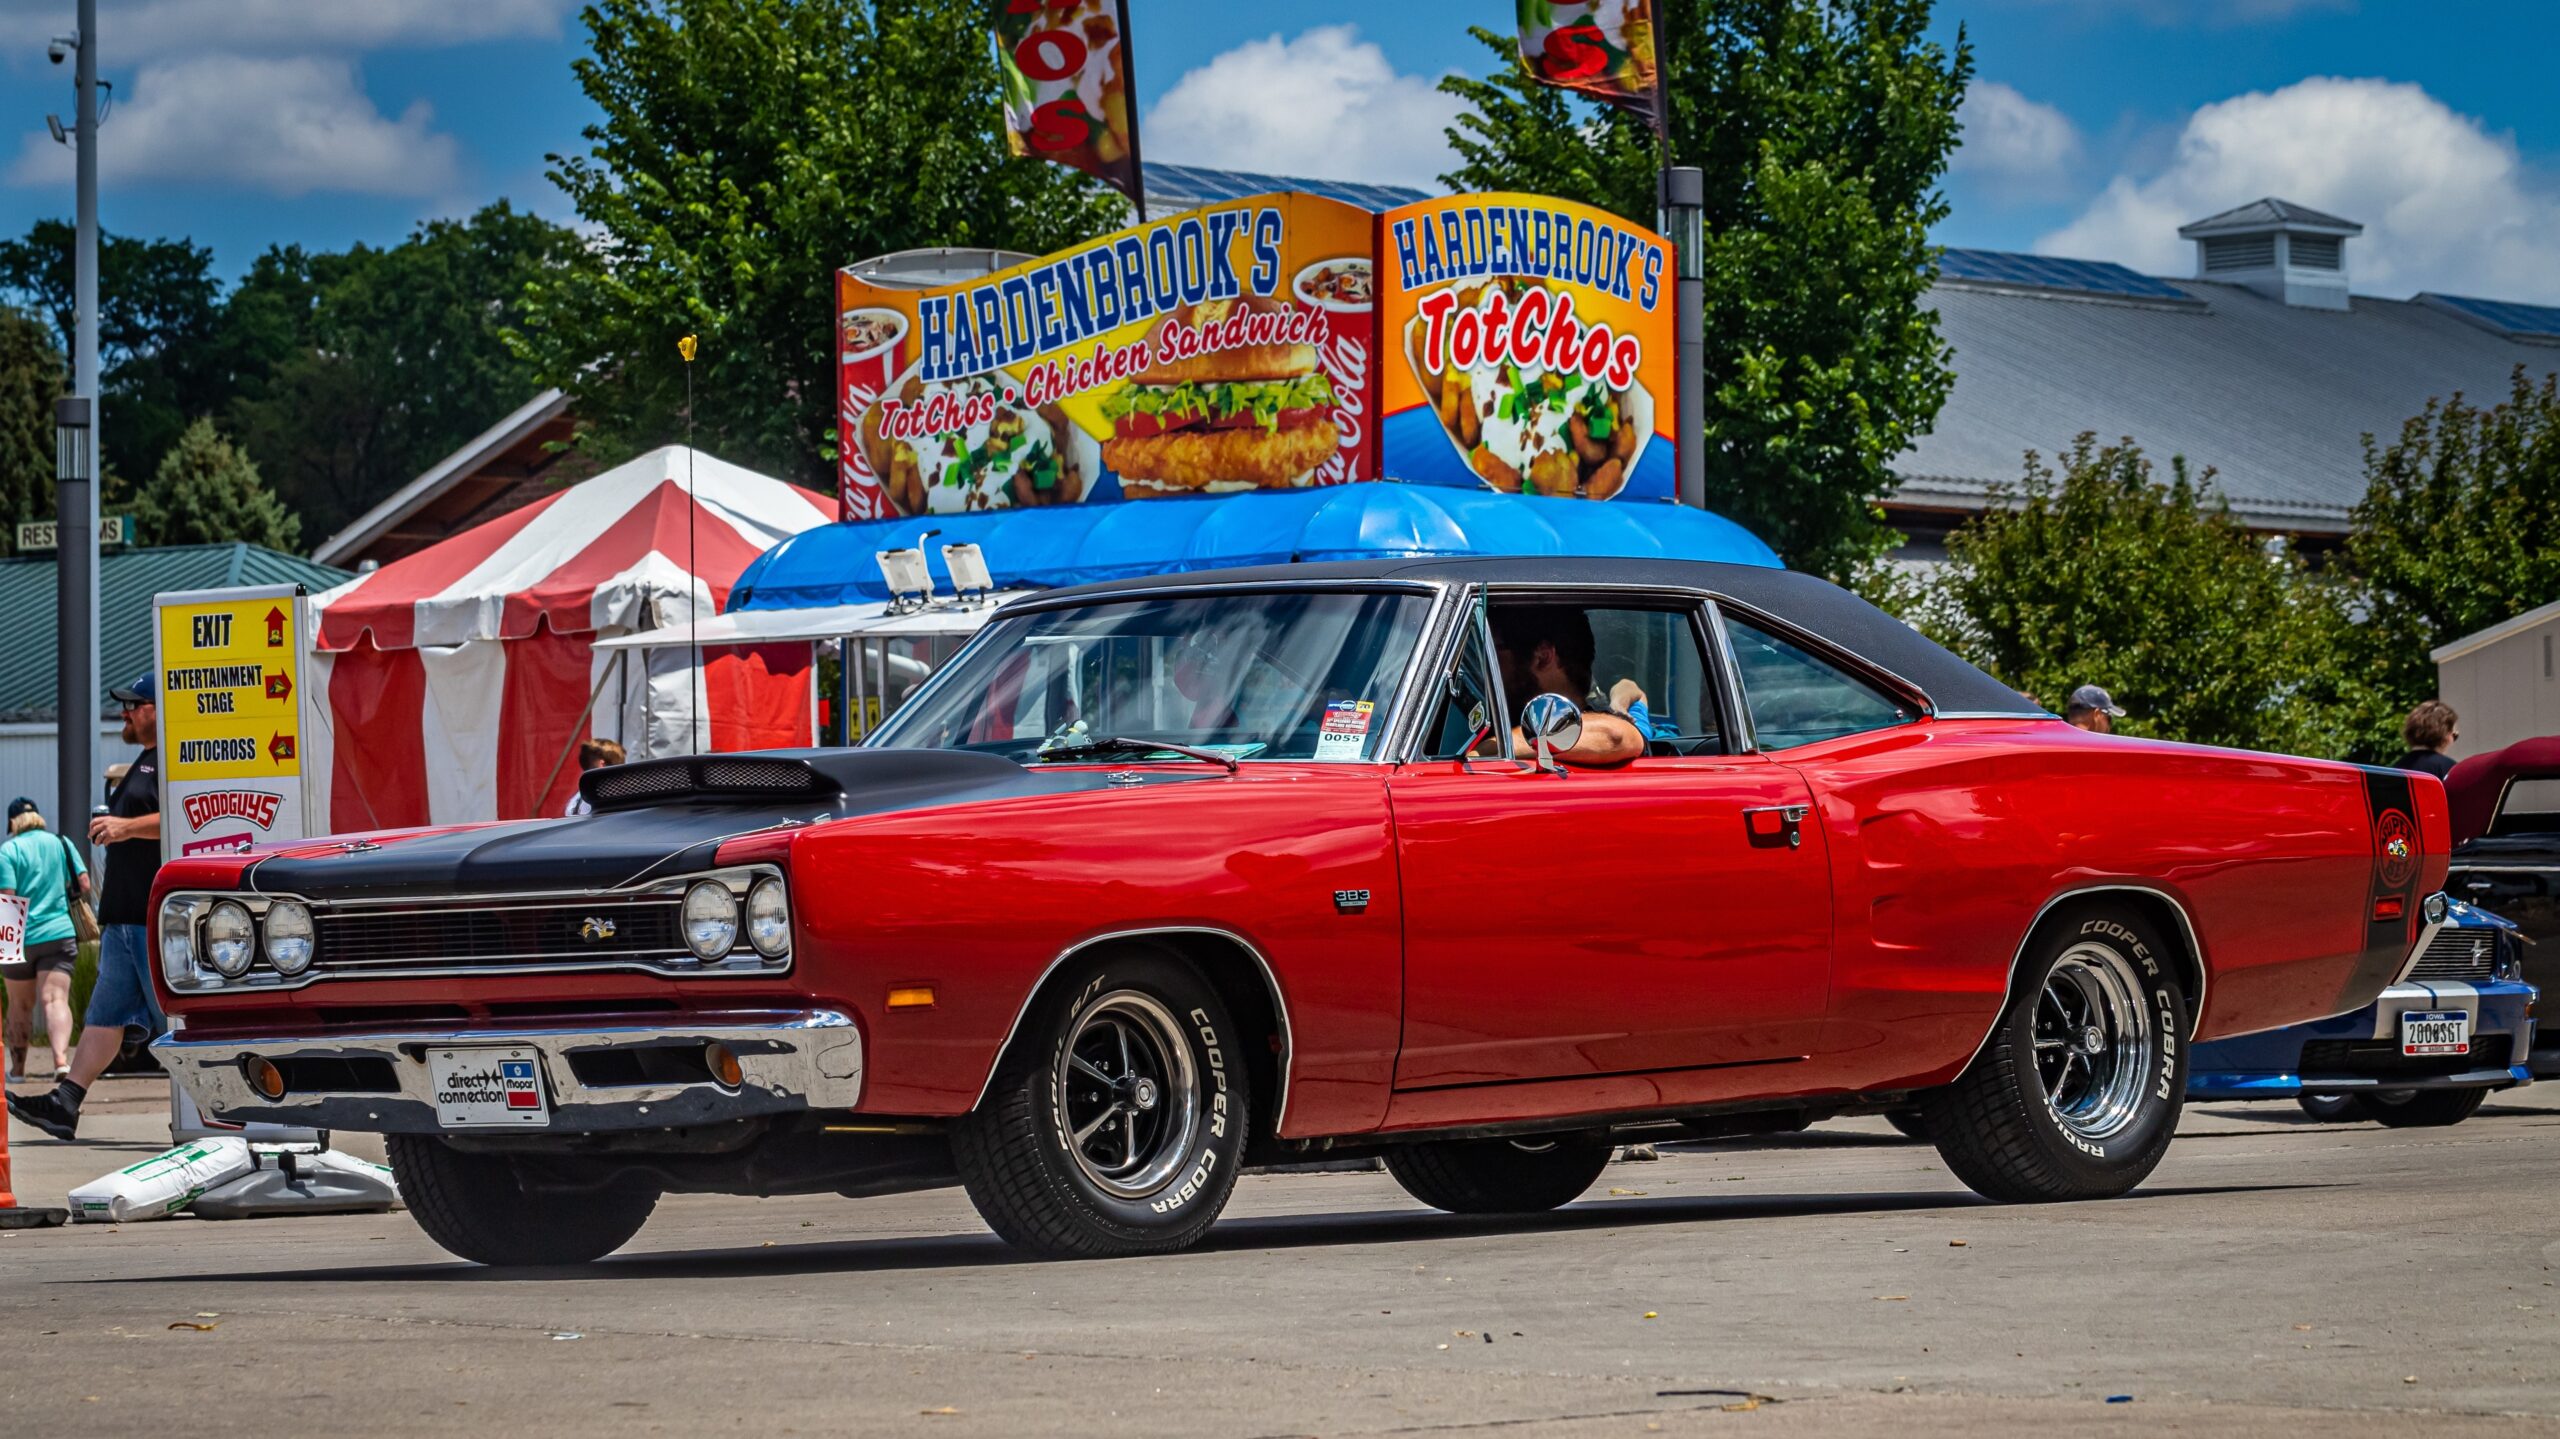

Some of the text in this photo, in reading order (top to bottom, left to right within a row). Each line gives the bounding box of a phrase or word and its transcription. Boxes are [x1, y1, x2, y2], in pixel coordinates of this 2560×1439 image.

[1392, 206, 1664, 312] HARDENBROOK'S
[917, 206, 1284, 383] HARDENBROOK'S
[1418, 286, 1640, 391] TotChos
[879, 301, 1329, 440] TotChos Chicken Sandwich
[192, 613, 233, 648] EXIT
[166, 665, 262, 691] ENTERTAINMENT
[197, 692, 235, 715] STAGE
[179, 738, 256, 763] AUTOCROSS
[1324, 733, 1360, 743] 0055
[183, 791, 281, 832] GOODGUYS
[2382, 816, 2412, 845] SUPER
[1335, 889, 1371, 901] 383
[0, 925, 15, 942] NG
[2079, 918, 2161, 978] COOPER
[2426, 1013, 2446, 1021] IOWA
[2156, 988, 2175, 1101] COBRA
[447, 1072, 483, 1089] direct
[1190, 1007, 1228, 1139] COOPER
[438, 1087, 505, 1104] connection
[1150, 1148, 1217, 1214] COBRA
